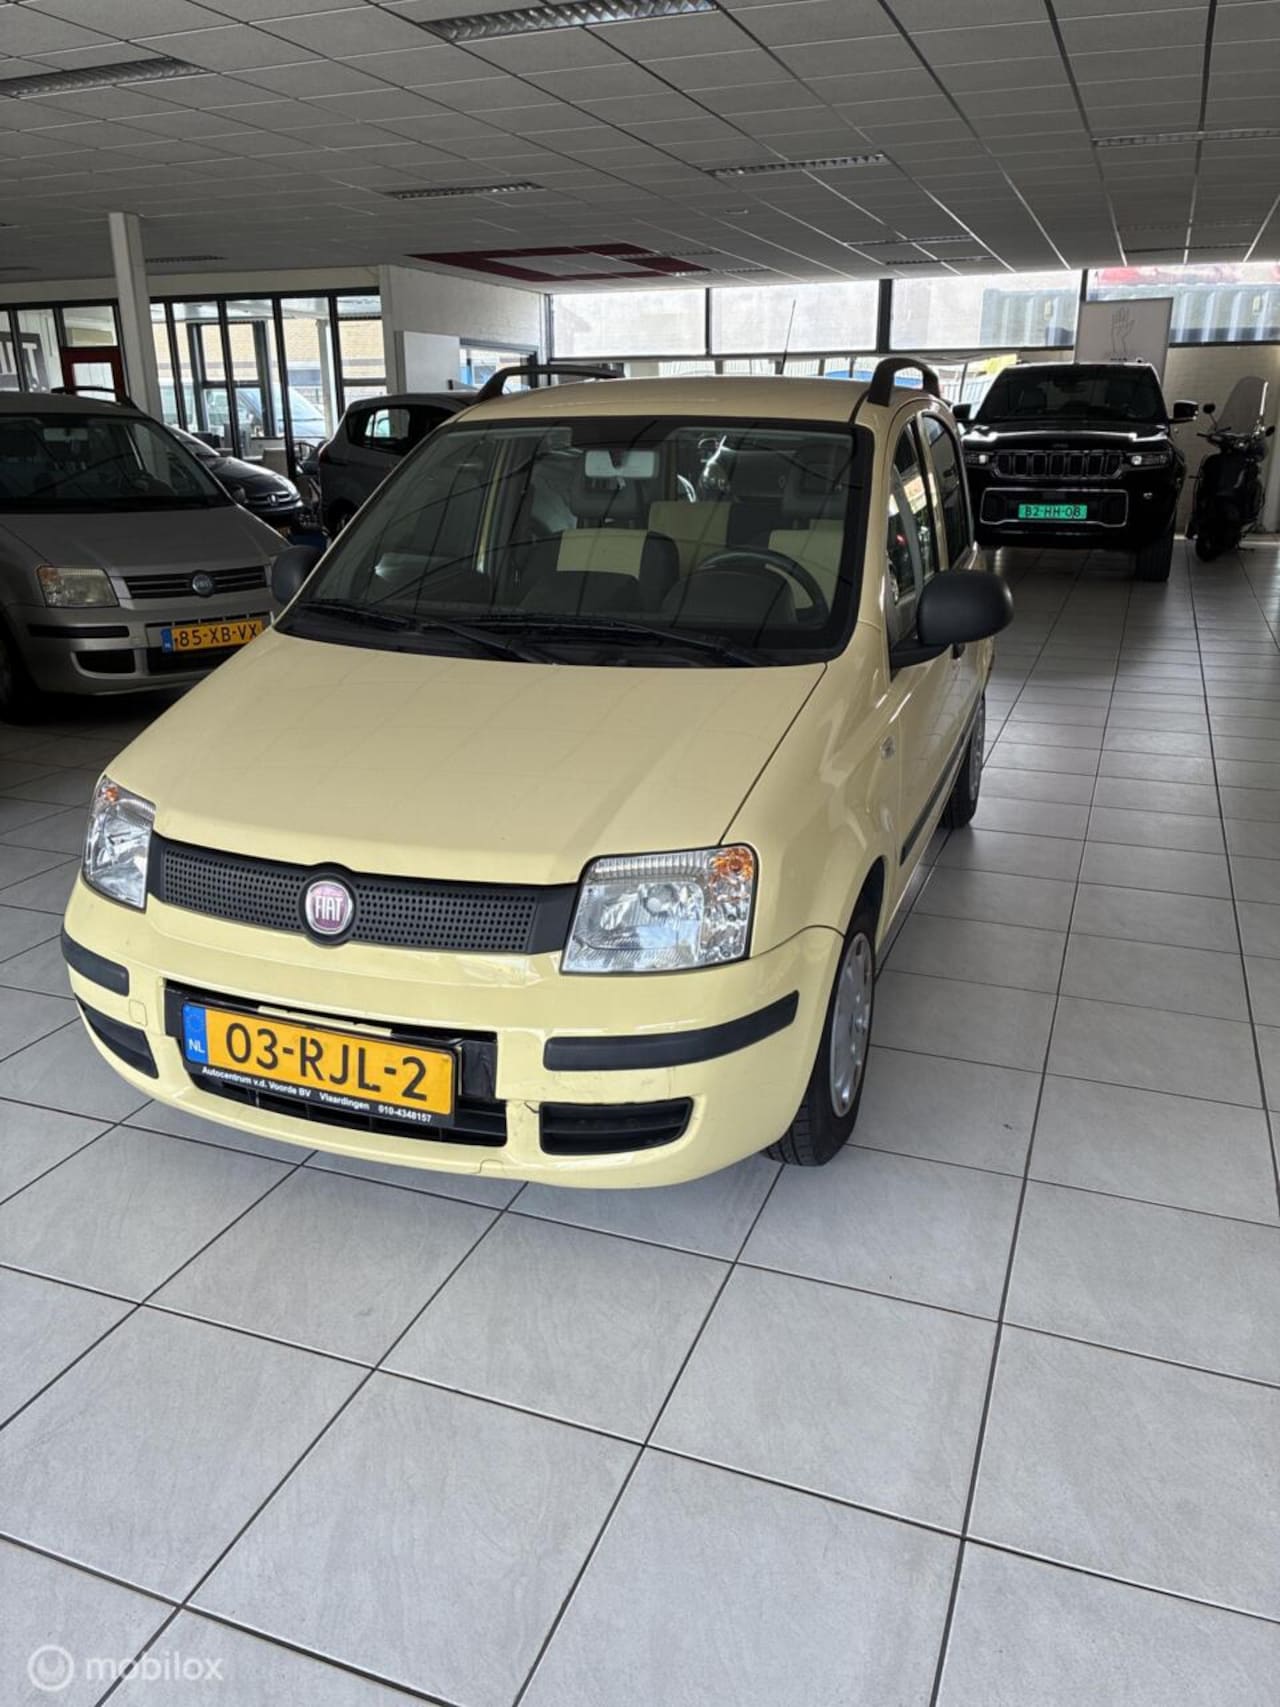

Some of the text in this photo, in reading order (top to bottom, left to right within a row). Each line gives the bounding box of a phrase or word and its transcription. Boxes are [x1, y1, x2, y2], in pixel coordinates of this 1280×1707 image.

[315, 895, 343, 921] FIAT
[188, 1038, 206, 1054] NL
[225, 1022, 428, 1101] 03-RJL-2
[202, 1066, 252, 1085] Autocentrum
[253, 1079, 268, 1088] v.d.
[269, 1081, 297, 1095] Voorde
[298, 1088, 312, 1098] BV
[319, 1092, 370, 1111] Vlaardingen
